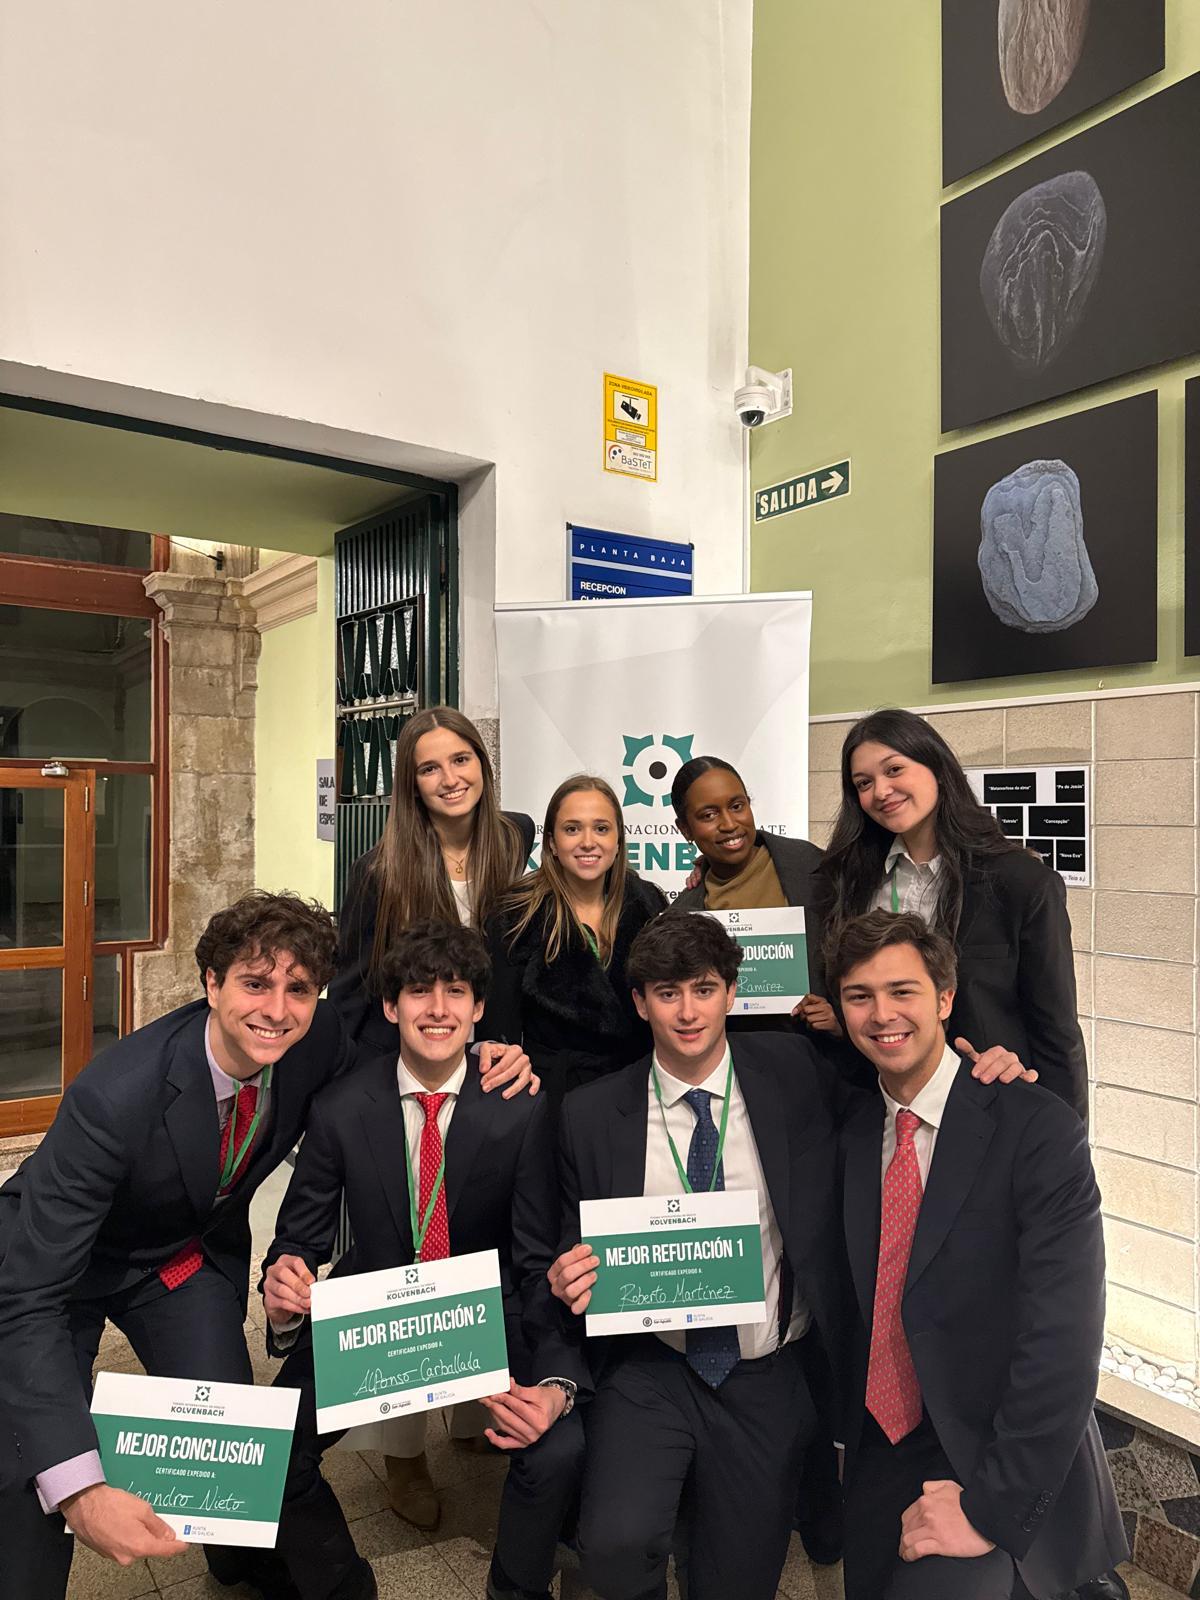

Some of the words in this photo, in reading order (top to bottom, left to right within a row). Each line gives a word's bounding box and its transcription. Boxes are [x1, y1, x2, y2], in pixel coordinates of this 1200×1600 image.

[622, 455, 652, 470] BaSTeT
[760, 478, 817, 515] SALIDA
[580, 544, 638, 559] PLANTA
[650, 554, 686, 566] BAJA
[580, 581, 626, 596] RECEPCION
[319, 776, 336, 788] SALA
[320, 795, 328, 806] DE
[742, 942, 794, 960] ODUCCIÓN
[650, 1217, 696, 1226] KOLVENBACH
[606, 1247, 650, 1267] MEJOR
[652, 1236, 733, 1264] REFUTACIÓN
[737, 1238, 744, 1257] 1
[386, 1286, 436, 1300] KOLVENBACH
[620, 1282, 667, 1312] Roberto
[338, 1323, 387, 1352] MEJOR
[390, 1304, 475, 1342] REFUTACIÓN
[477, 1304, 487, 1324] 2
[388, 1346, 416, 1358] CERTIFICADO
[420, 1352, 480, 1381] Carballada
[171, 1406, 225, 1417] KOLVENBACH
[115, 1431, 168, 1458] MEJOR
[169, 1436, 265, 1465] CONCLUSIÓN
[156, 1467, 186, 1476] CERTIFICADO
[186, 1470, 210, 1478] EXPEDIDO
[200, 1485, 246, 1511] Nieto
